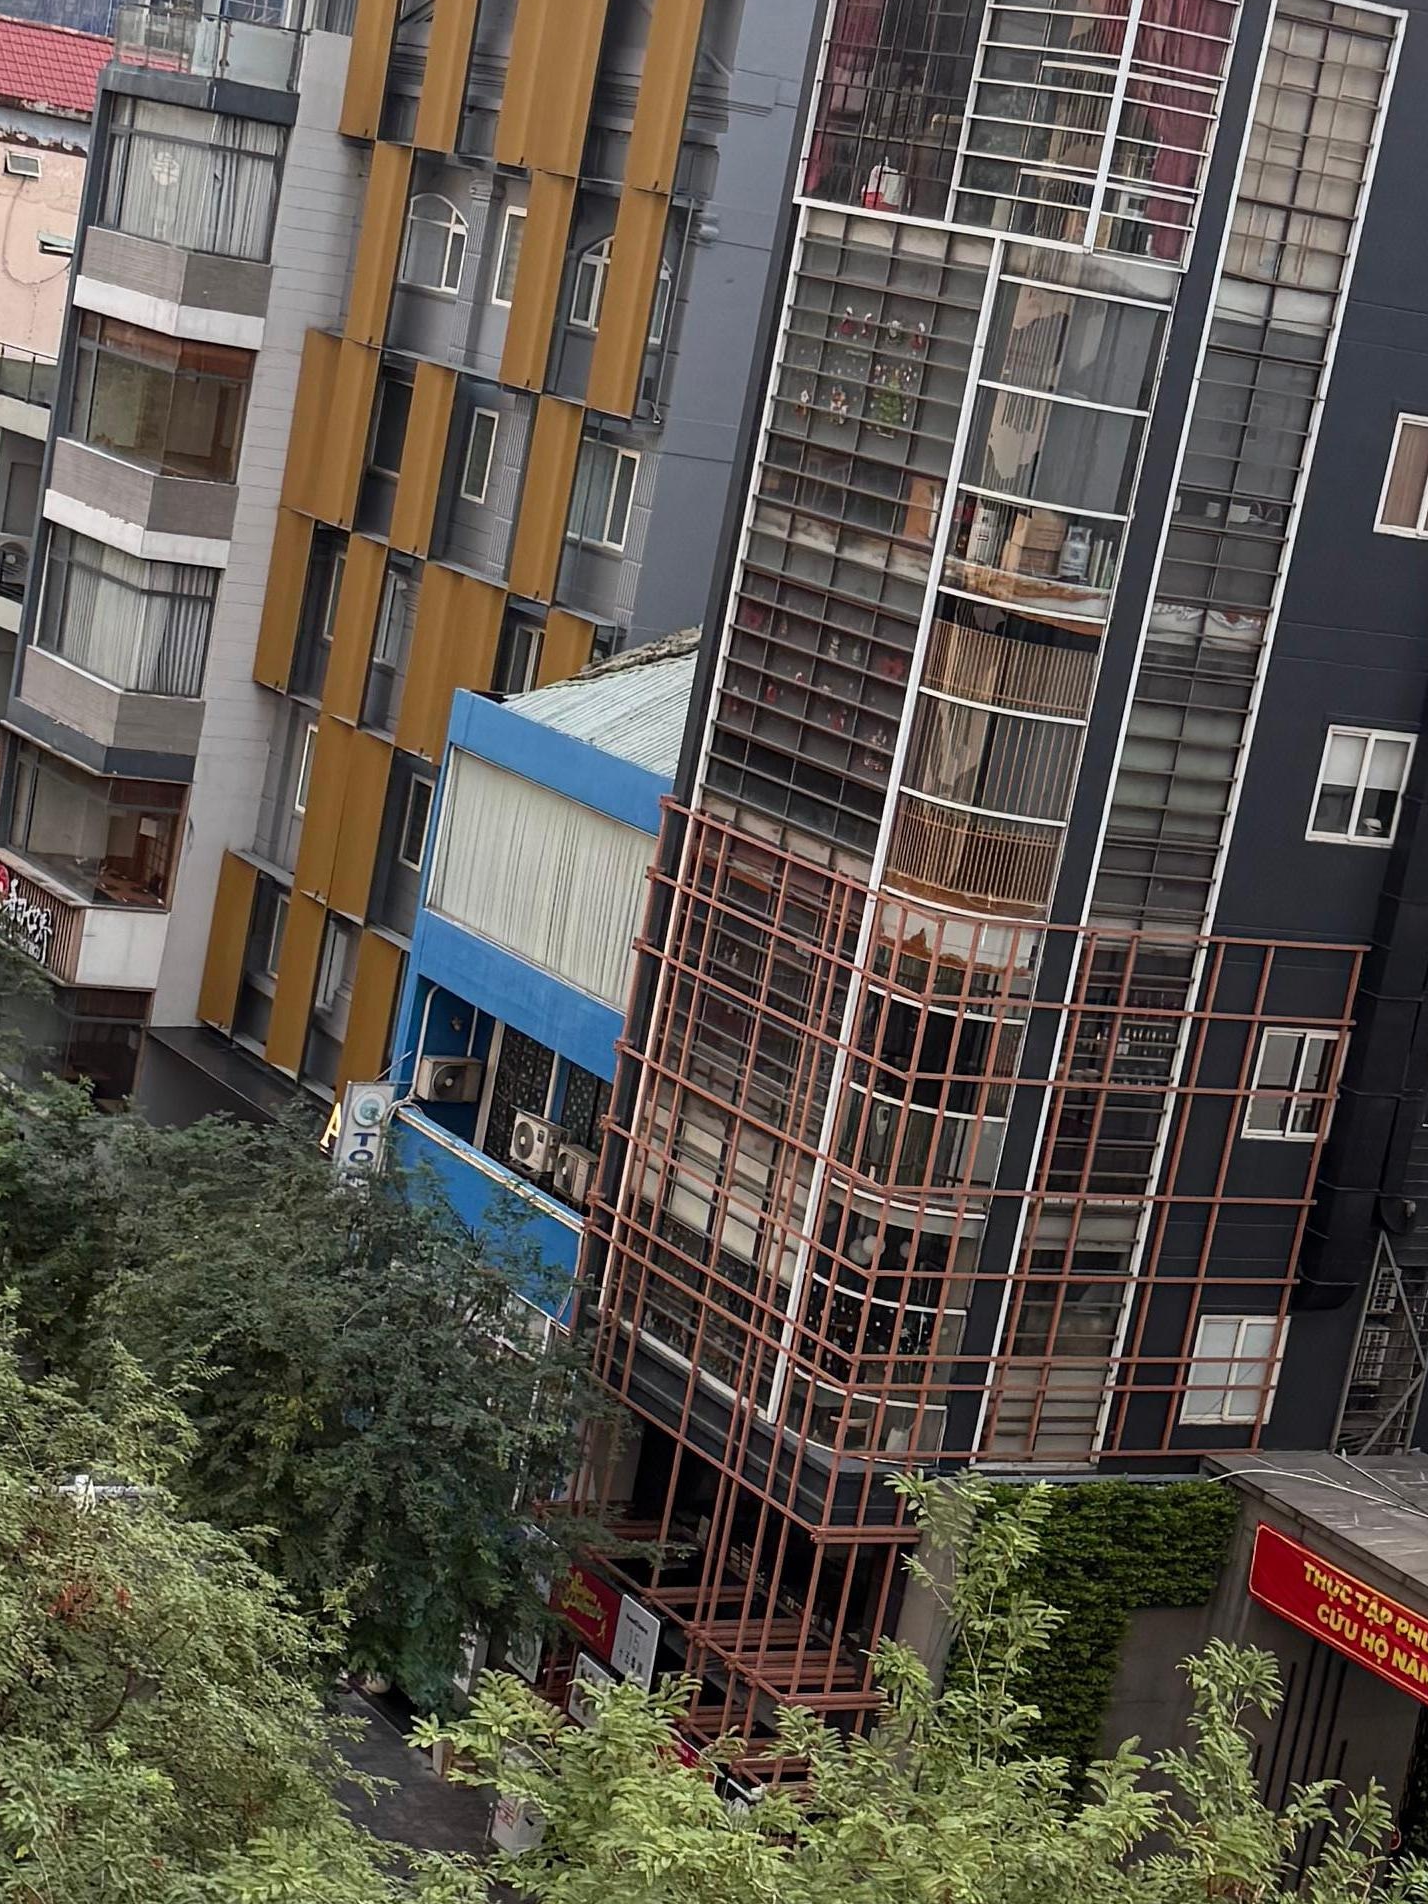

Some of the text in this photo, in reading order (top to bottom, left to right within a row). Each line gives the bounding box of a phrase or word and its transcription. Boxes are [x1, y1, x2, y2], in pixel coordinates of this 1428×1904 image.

[1304, 1561, 1353, 1605] THỰC
[1355, 1592, 1394, 1627] TẬP
[1317, 1604, 1359, 1641] CỨU
[1361, 1629, 1389, 1665] HỘ
